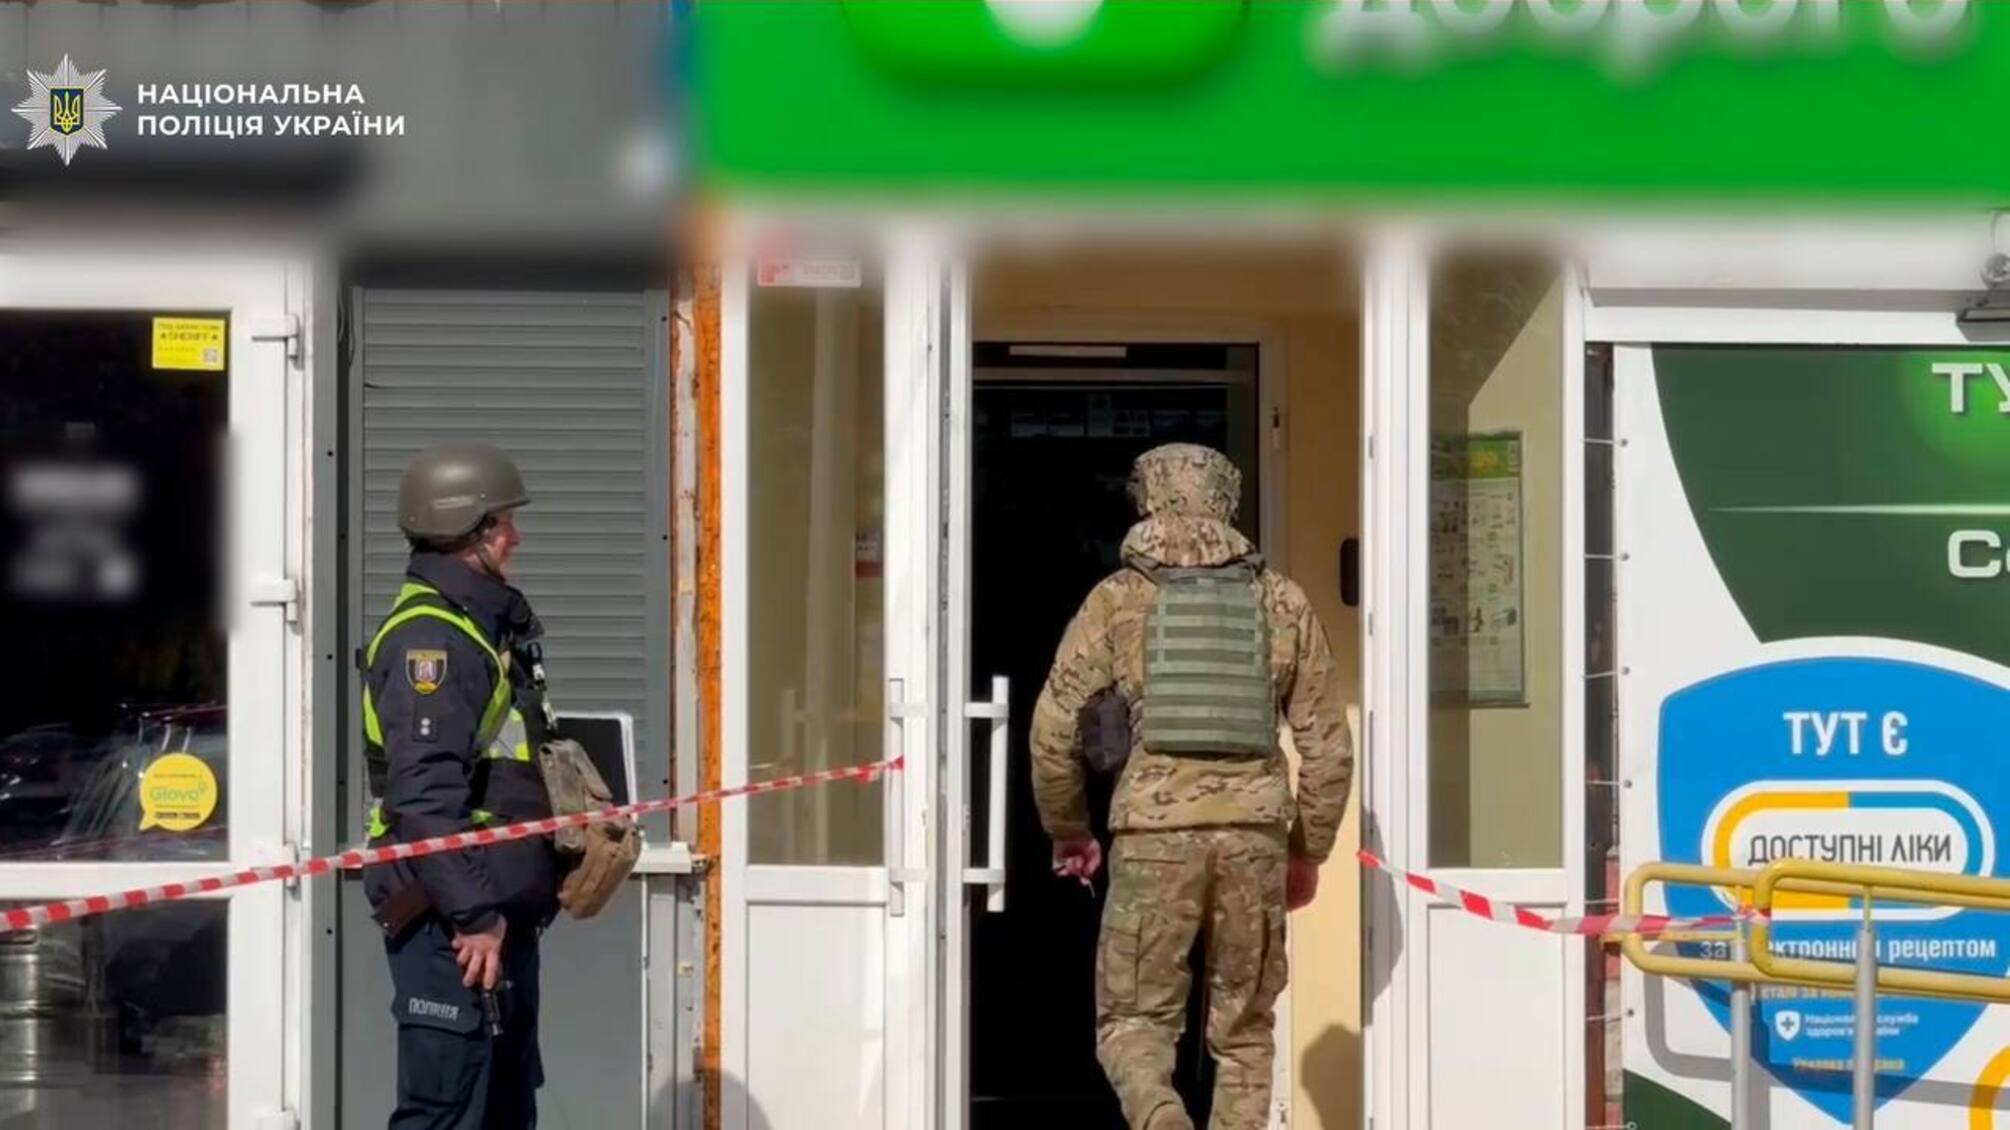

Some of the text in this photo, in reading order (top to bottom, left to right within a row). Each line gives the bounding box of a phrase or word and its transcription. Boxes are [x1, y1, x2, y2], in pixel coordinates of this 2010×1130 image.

[1783, 711, 1909, 756] ТУТ Є
[1748, 835, 1951, 866] ДОСТУПНІ ЛІКИ
[1700, 941, 1728, 959] за
[1888, 939, 1997, 964] рецептом
